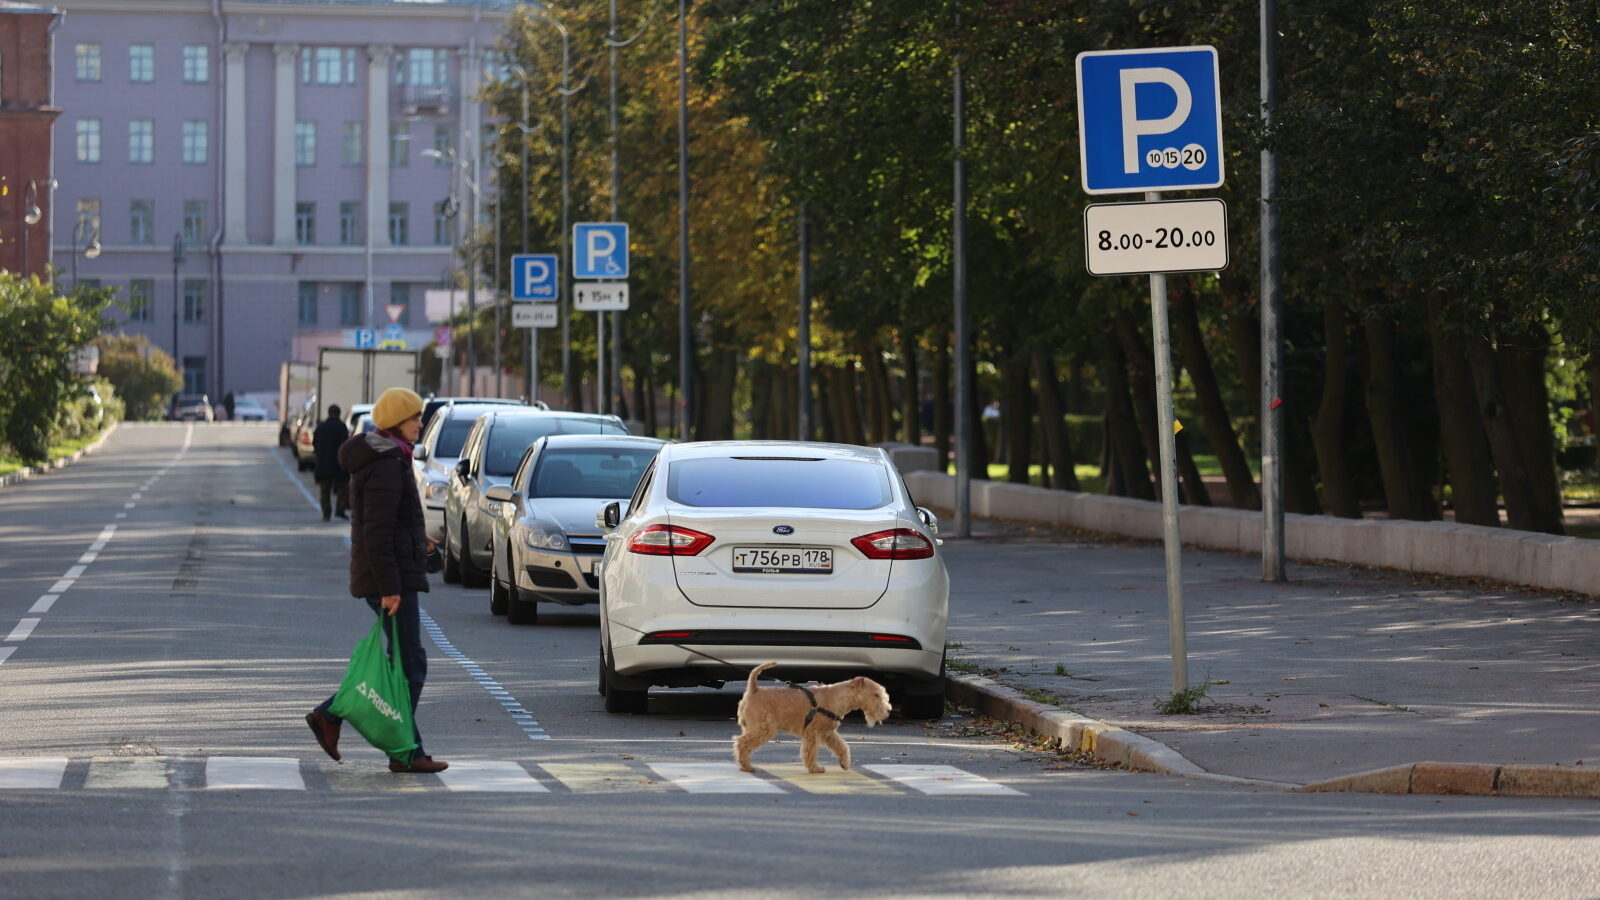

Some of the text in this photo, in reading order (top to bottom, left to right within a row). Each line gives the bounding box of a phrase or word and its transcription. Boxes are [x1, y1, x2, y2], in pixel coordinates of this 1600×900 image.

[1119, 67, 1193, 174] P
[1149, 149, 1205, 165] 10 15 20
[587, 229, 617, 272] P
[1098, 227, 1215, 251] 8.00-20.00
[524, 260, 549, 296] P
[804, 550, 828, 563] 178
[367, 687, 403, 723] PRISMA
